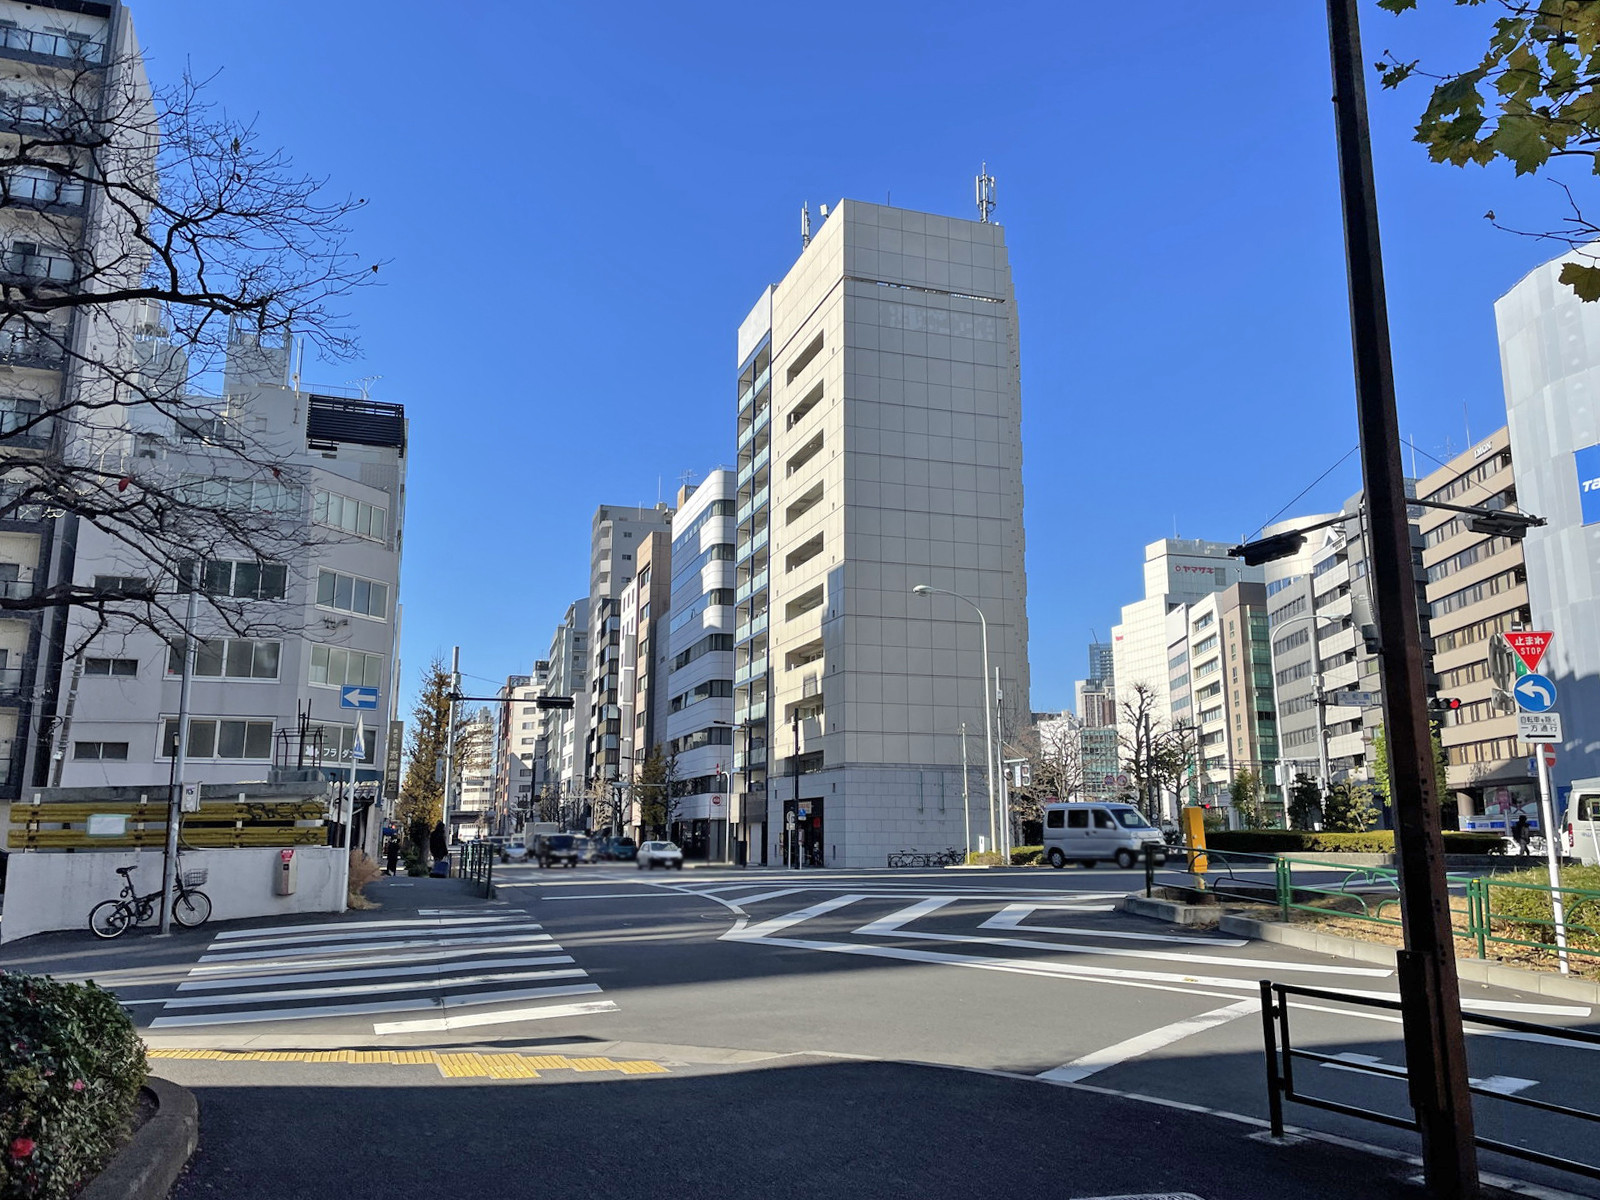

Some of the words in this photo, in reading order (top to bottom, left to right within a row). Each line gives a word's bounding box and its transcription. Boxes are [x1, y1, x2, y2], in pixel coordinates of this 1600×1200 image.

[1183, 565, 1214, 574] ヤマザキ
[1514, 635, 1545, 646] 止まれ
[1520, 647, 1542, 655] STOP
[1520, 724, 1558, 732] 一方通行
